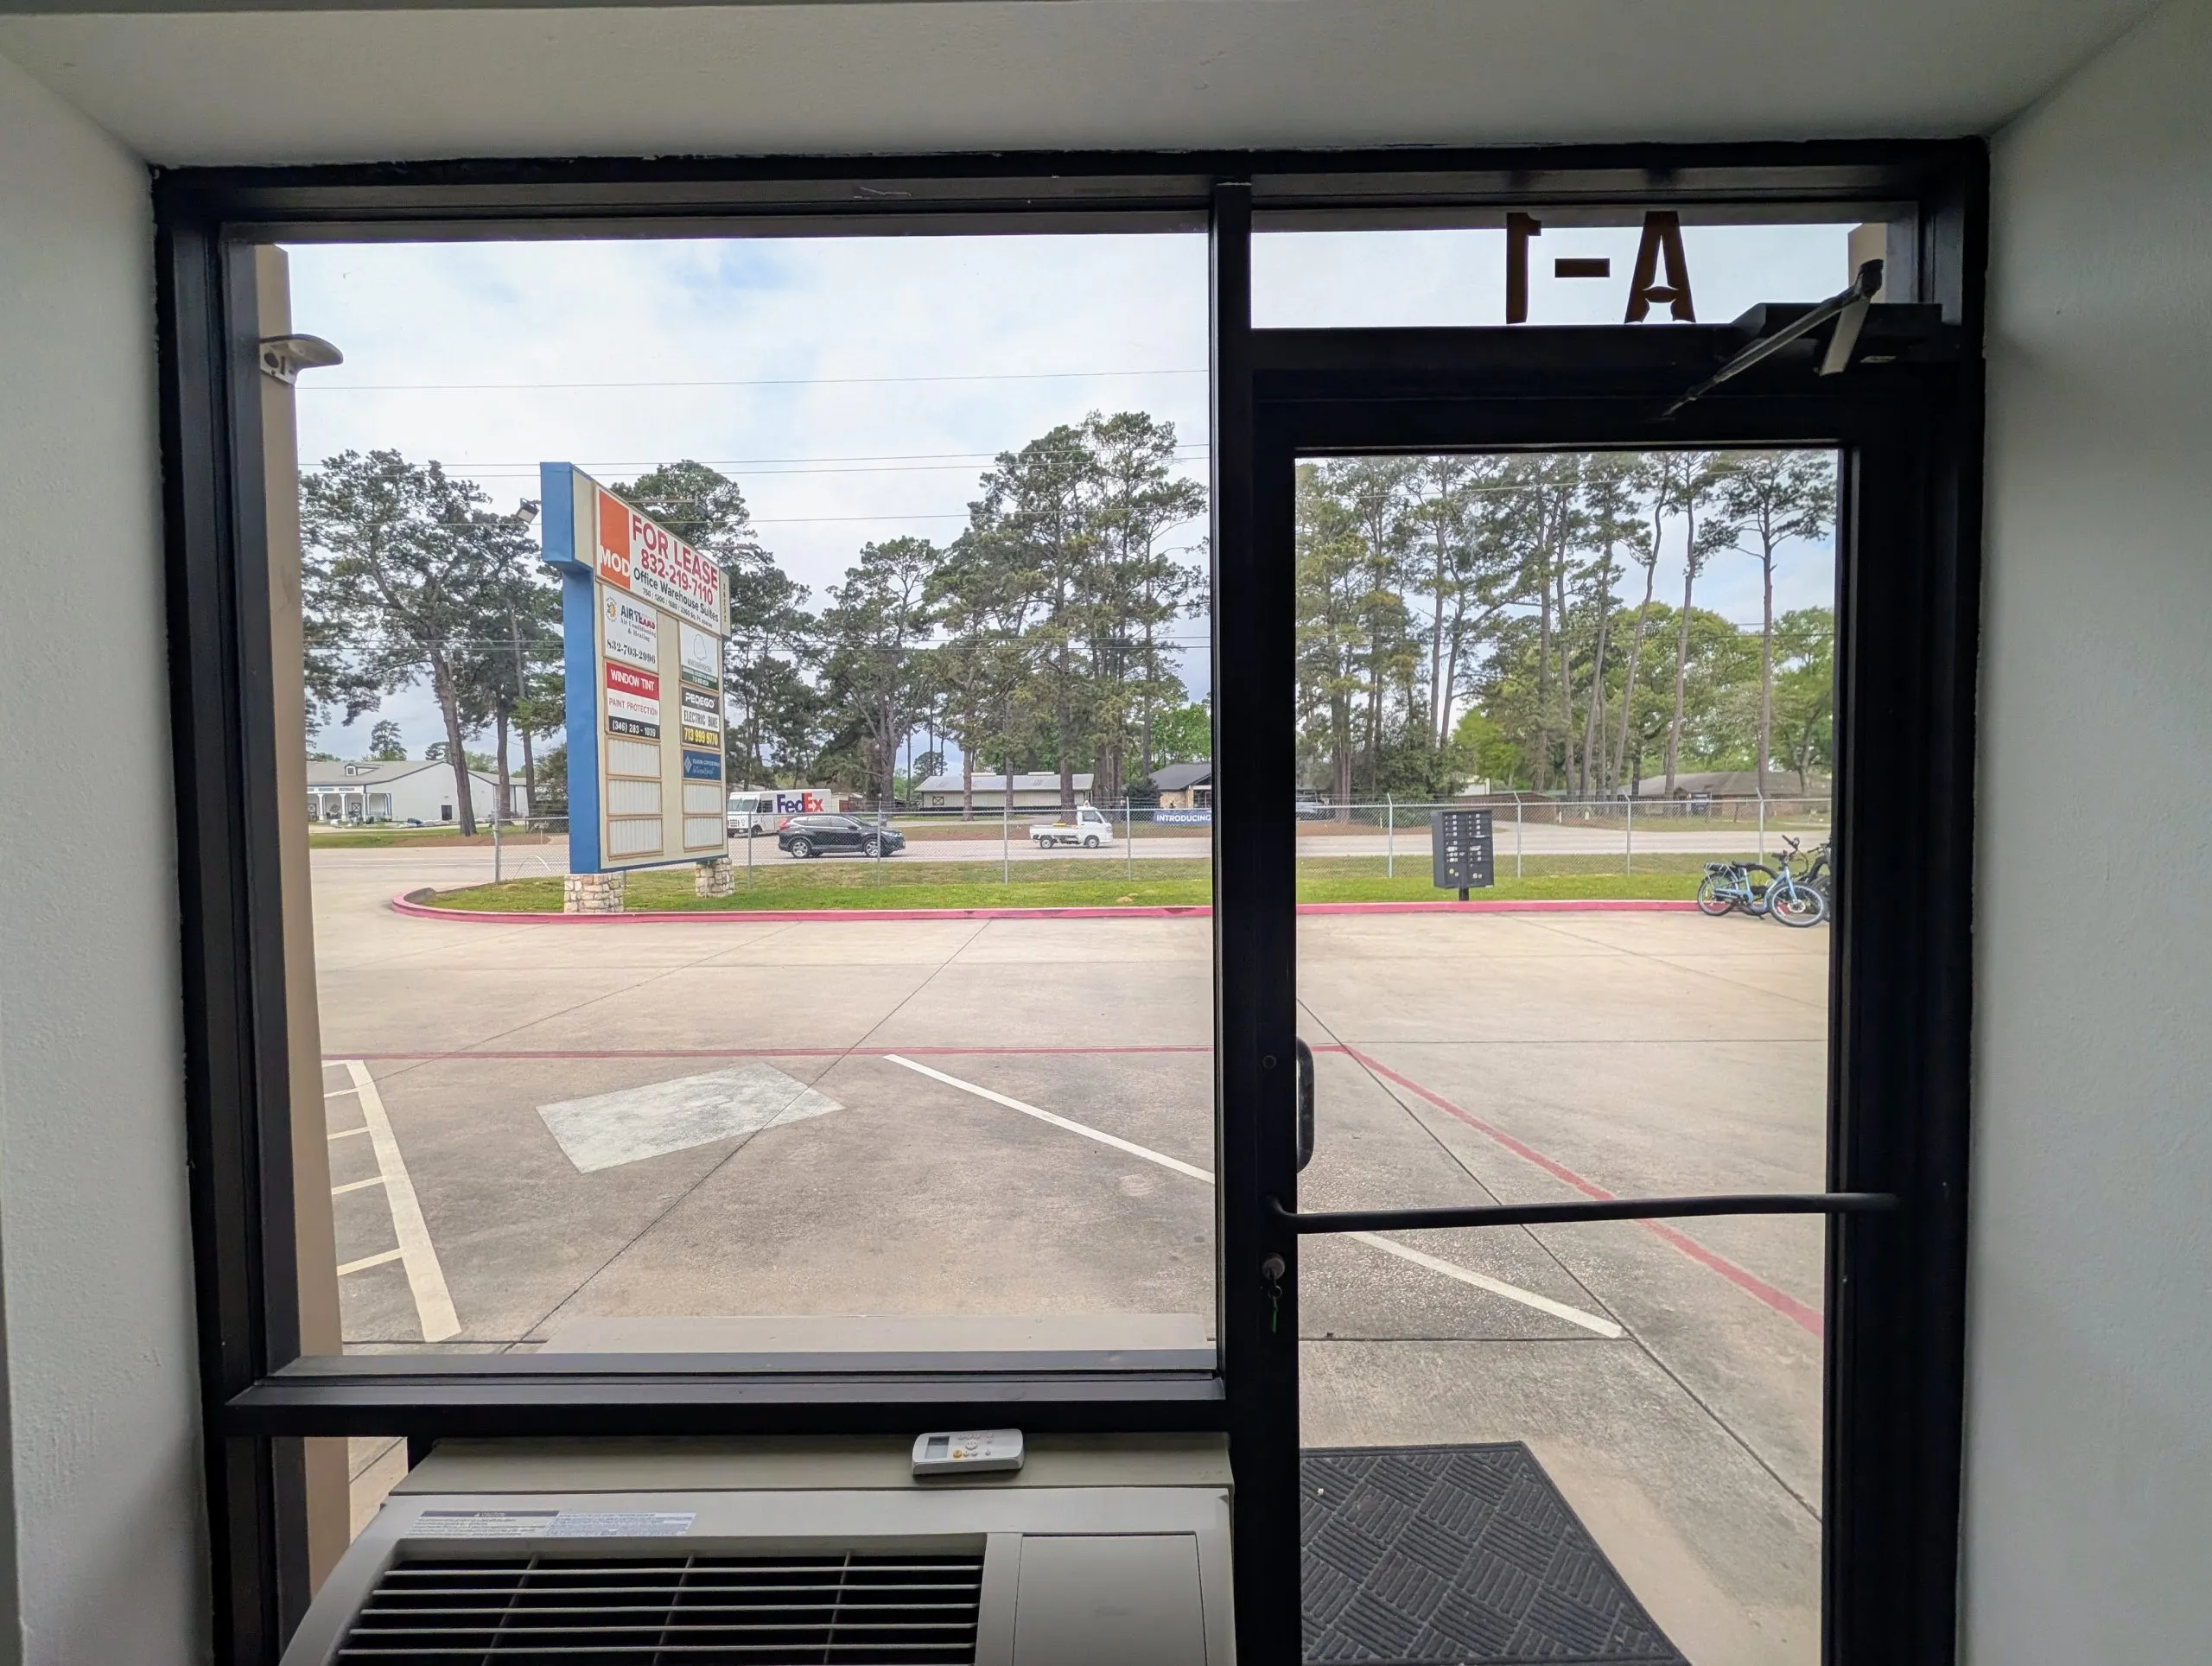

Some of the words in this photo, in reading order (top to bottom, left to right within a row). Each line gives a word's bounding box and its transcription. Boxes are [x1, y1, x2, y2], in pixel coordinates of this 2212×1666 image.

[600, 544, 630, 576] MOD
[632, 514, 669, 559] FOR
[673, 540, 718, 591] LEASE
[640, 549, 713, 606] 832-219-7110
[633, 568, 658, 589] Office
[659, 580, 699, 611] Warehouse
[700, 603, 719, 622] Suites
[610, 669, 639, 688] WINDOW
[640, 677, 655, 691] TINT
[608, 697, 626, 709] PAINT
[626, 701, 658, 716] PROTECTION
[685, 692, 715, 709] PEDEGO
[612, 720, 628, 733] (346)
[629, 723, 639, 734] 283
[683, 709, 706, 726] ELECTRIC
[708, 714, 718, 728] BIKE
[684, 728, 694, 742] 713
[777, 792, 825, 813] FedEx
